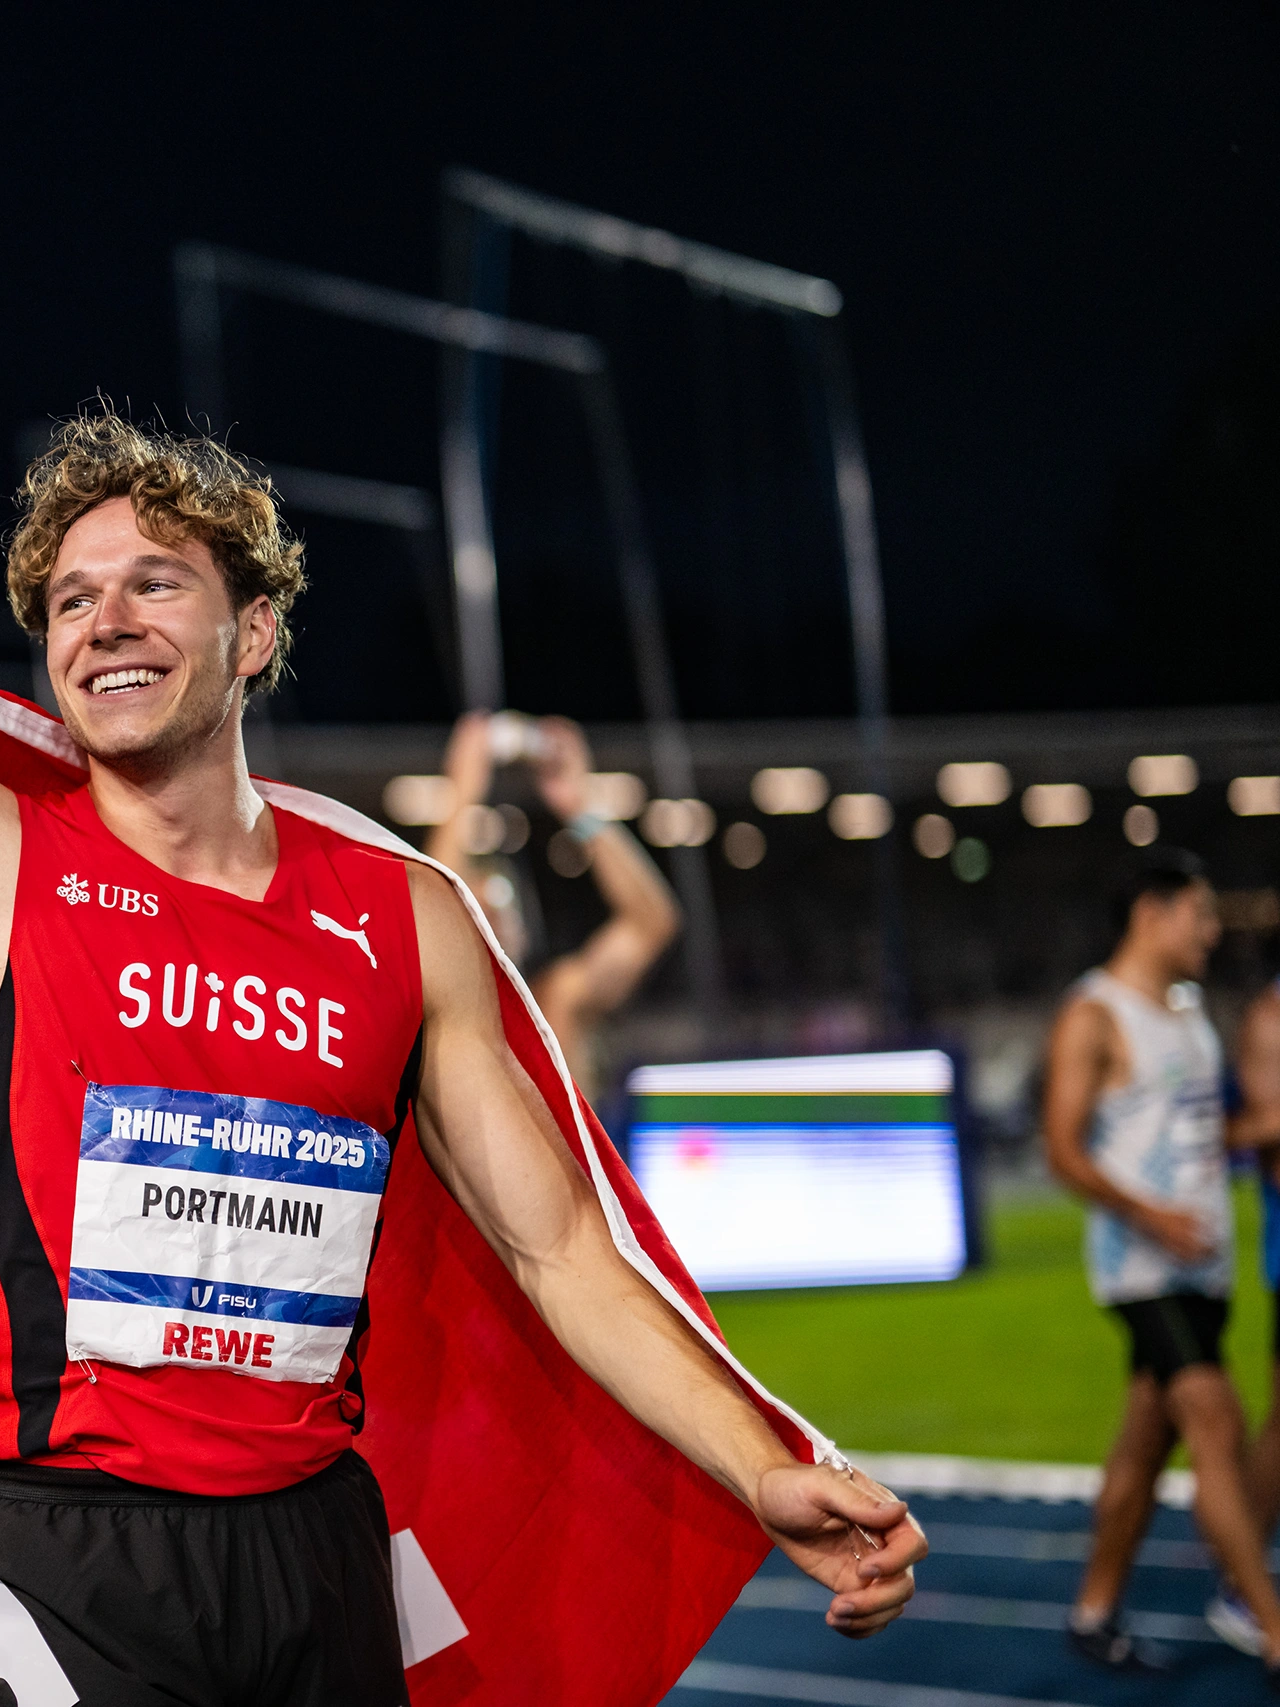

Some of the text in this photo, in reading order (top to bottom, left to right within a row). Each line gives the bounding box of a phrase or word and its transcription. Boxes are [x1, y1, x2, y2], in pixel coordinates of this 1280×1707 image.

[97, 883, 160, 917] UBS
[110, 1106, 366, 1168] RHINE-RUHR 2025
[141, 1182, 324, 1239] PORTMANN
[218, 1293, 257, 1309] FISU
[162, 1321, 275, 1369] REWE
